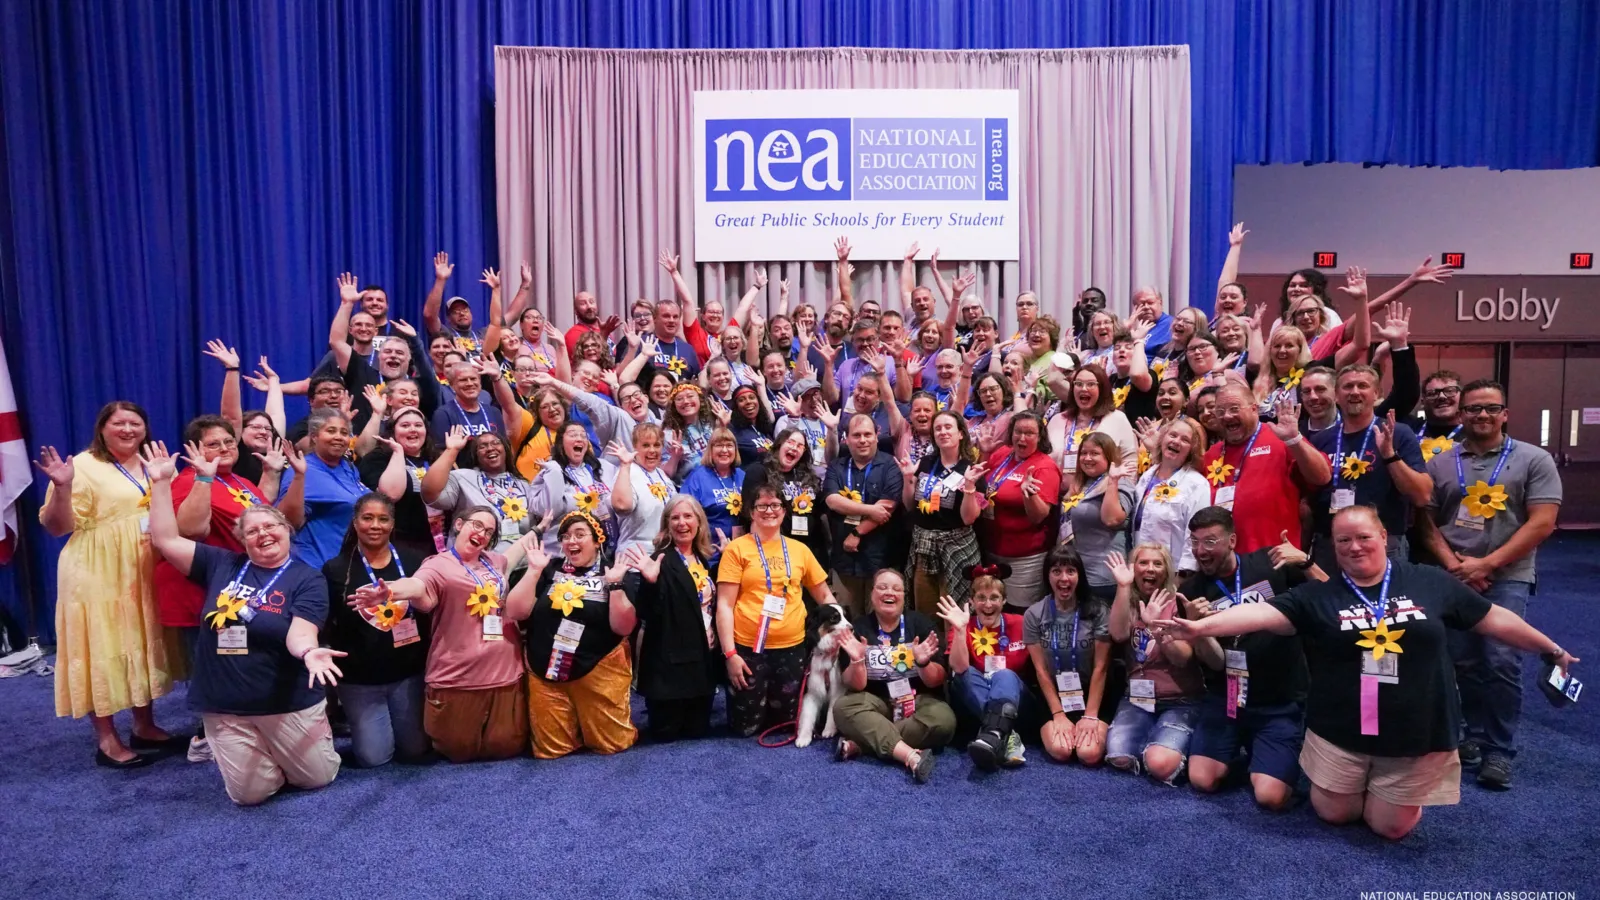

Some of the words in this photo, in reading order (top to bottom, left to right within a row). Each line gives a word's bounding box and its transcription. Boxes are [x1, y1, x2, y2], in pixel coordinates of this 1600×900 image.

[859, 129, 977, 146] NATIONAL
[713, 129, 844, 192] nea
[859, 153, 977, 169] EDUCATION
[988, 128, 1004, 192] nea.org
[859, 175, 977, 190] ASSOCIATION
[714, 213, 755, 228] Great
[761, 212, 807, 227] Public
[812, 212, 869, 227] Schools
[872, 213, 897, 230] for
[901, 212, 943, 230] Every
[948, 212, 1005, 226] Student
[1319, 253, 1335, 266] EXIT
[1447, 253, 1462, 267] EXIT
[1576, 253, 1591, 267] EXIT
[1457, 288, 1561, 330] Lobby
